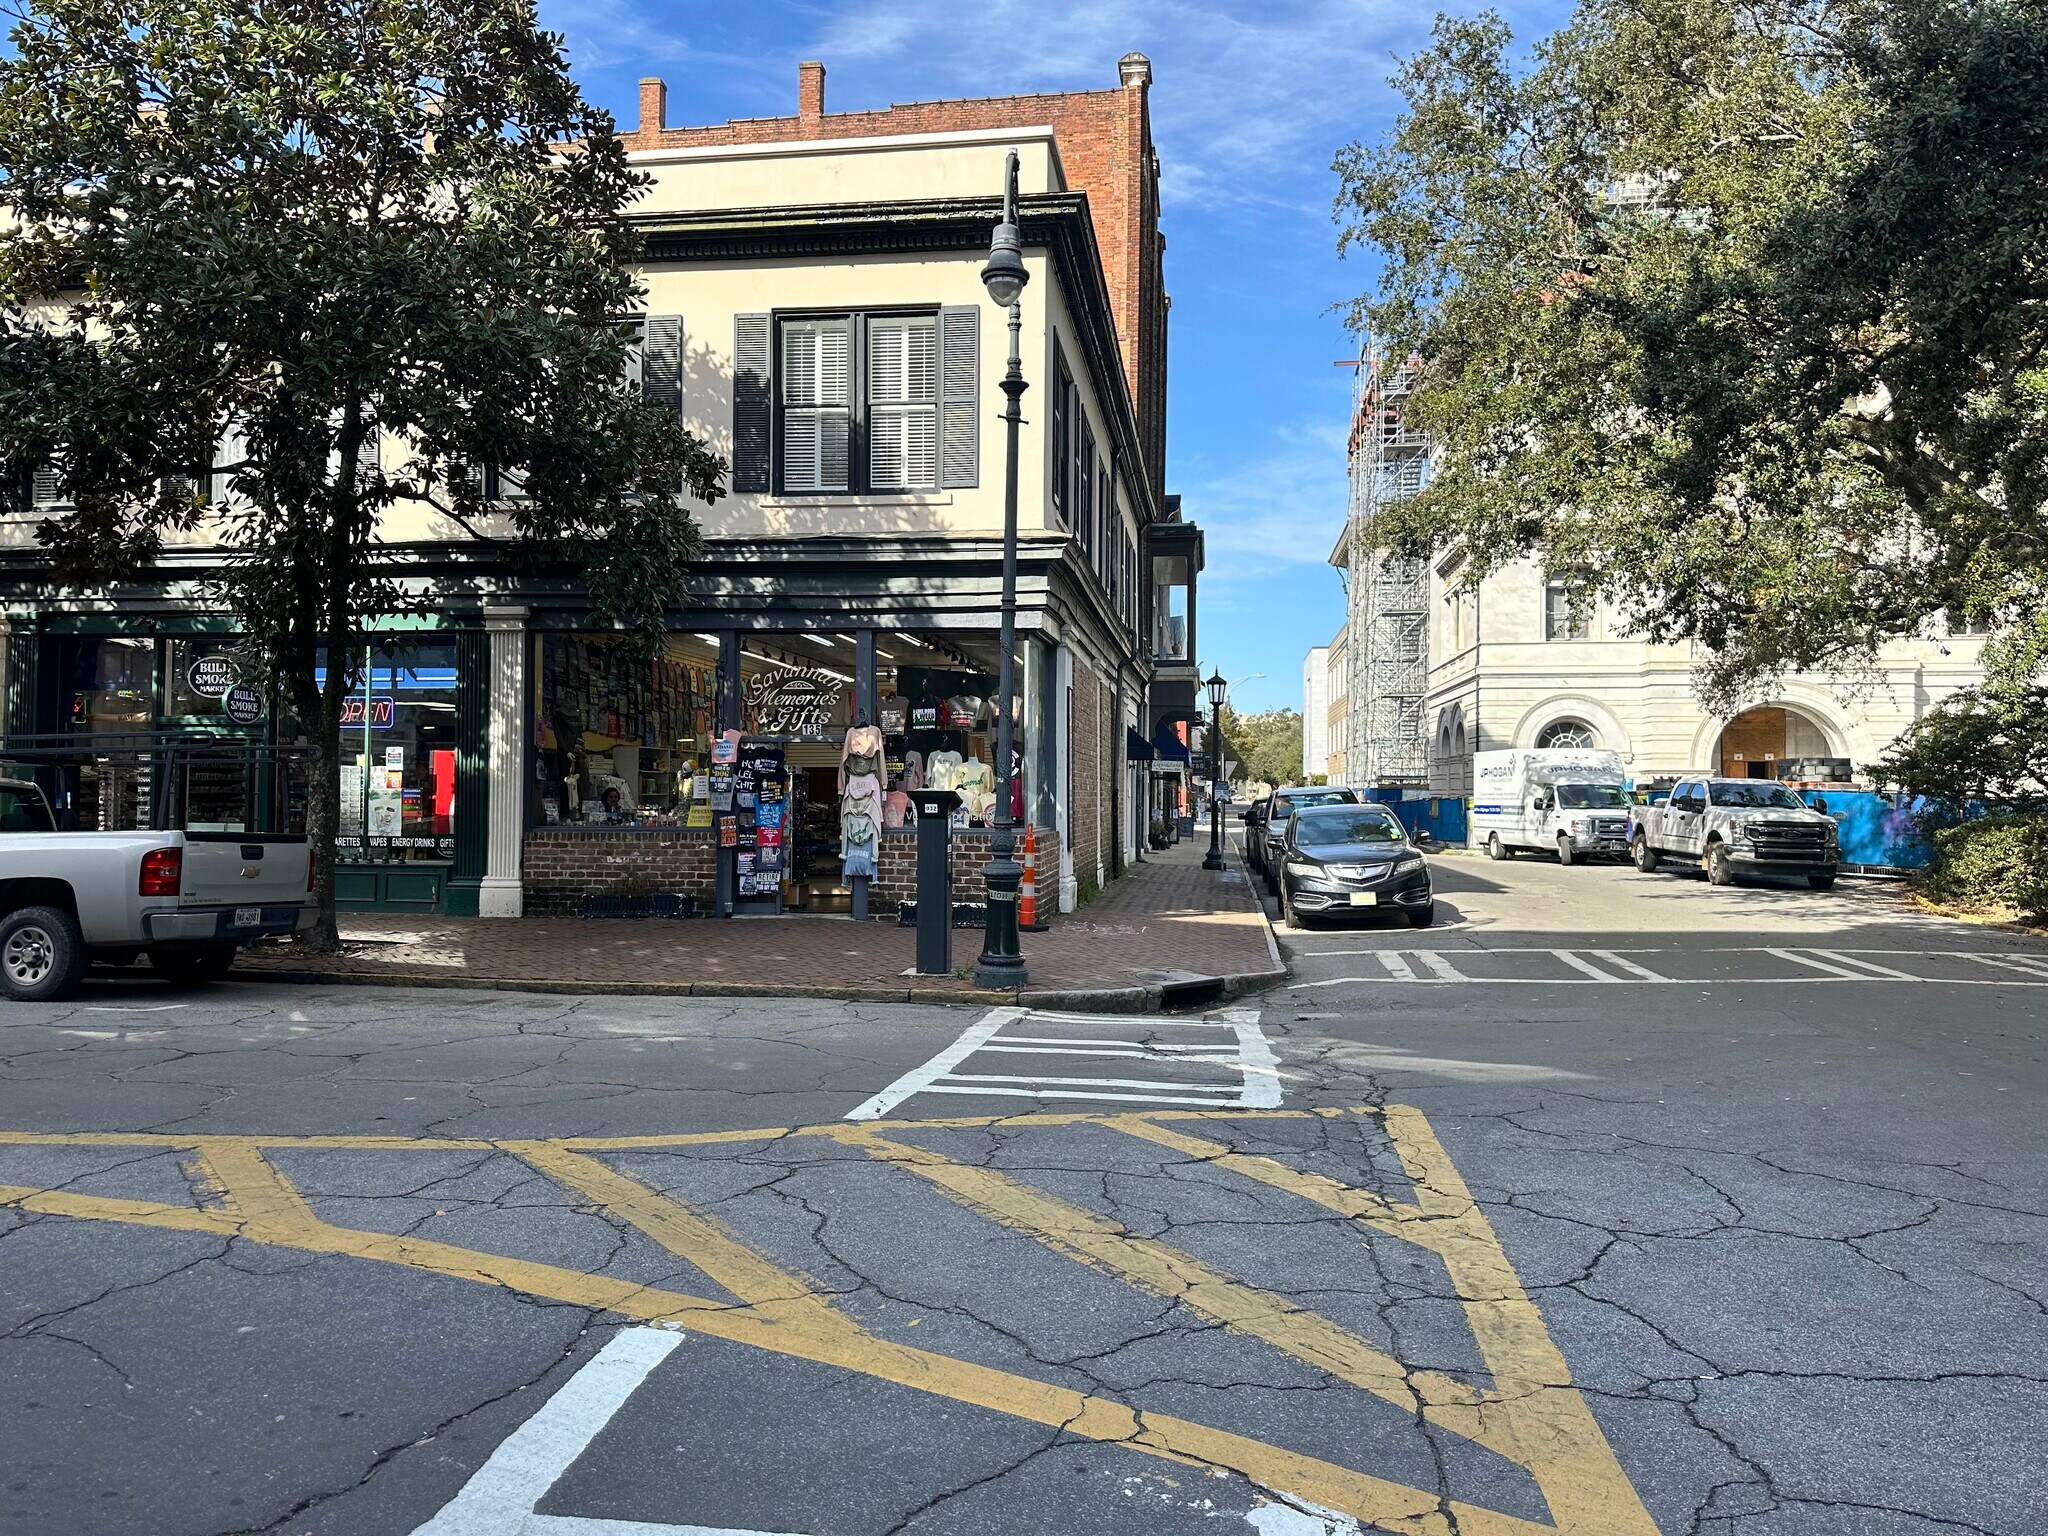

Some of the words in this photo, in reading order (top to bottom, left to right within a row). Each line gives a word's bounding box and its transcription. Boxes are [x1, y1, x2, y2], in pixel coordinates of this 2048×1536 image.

[751, 665, 843, 695] Savannah
[234, 690, 255, 701] BULL
[230, 701, 258, 712] SMOKE
[768, 705, 832, 731] Gifts
[803, 724, 820, 735] 135
[370, 837, 387, 846] VAPES
[392, 837, 414, 847] ENERGY
[415, 838, 435, 847] DRINKS
